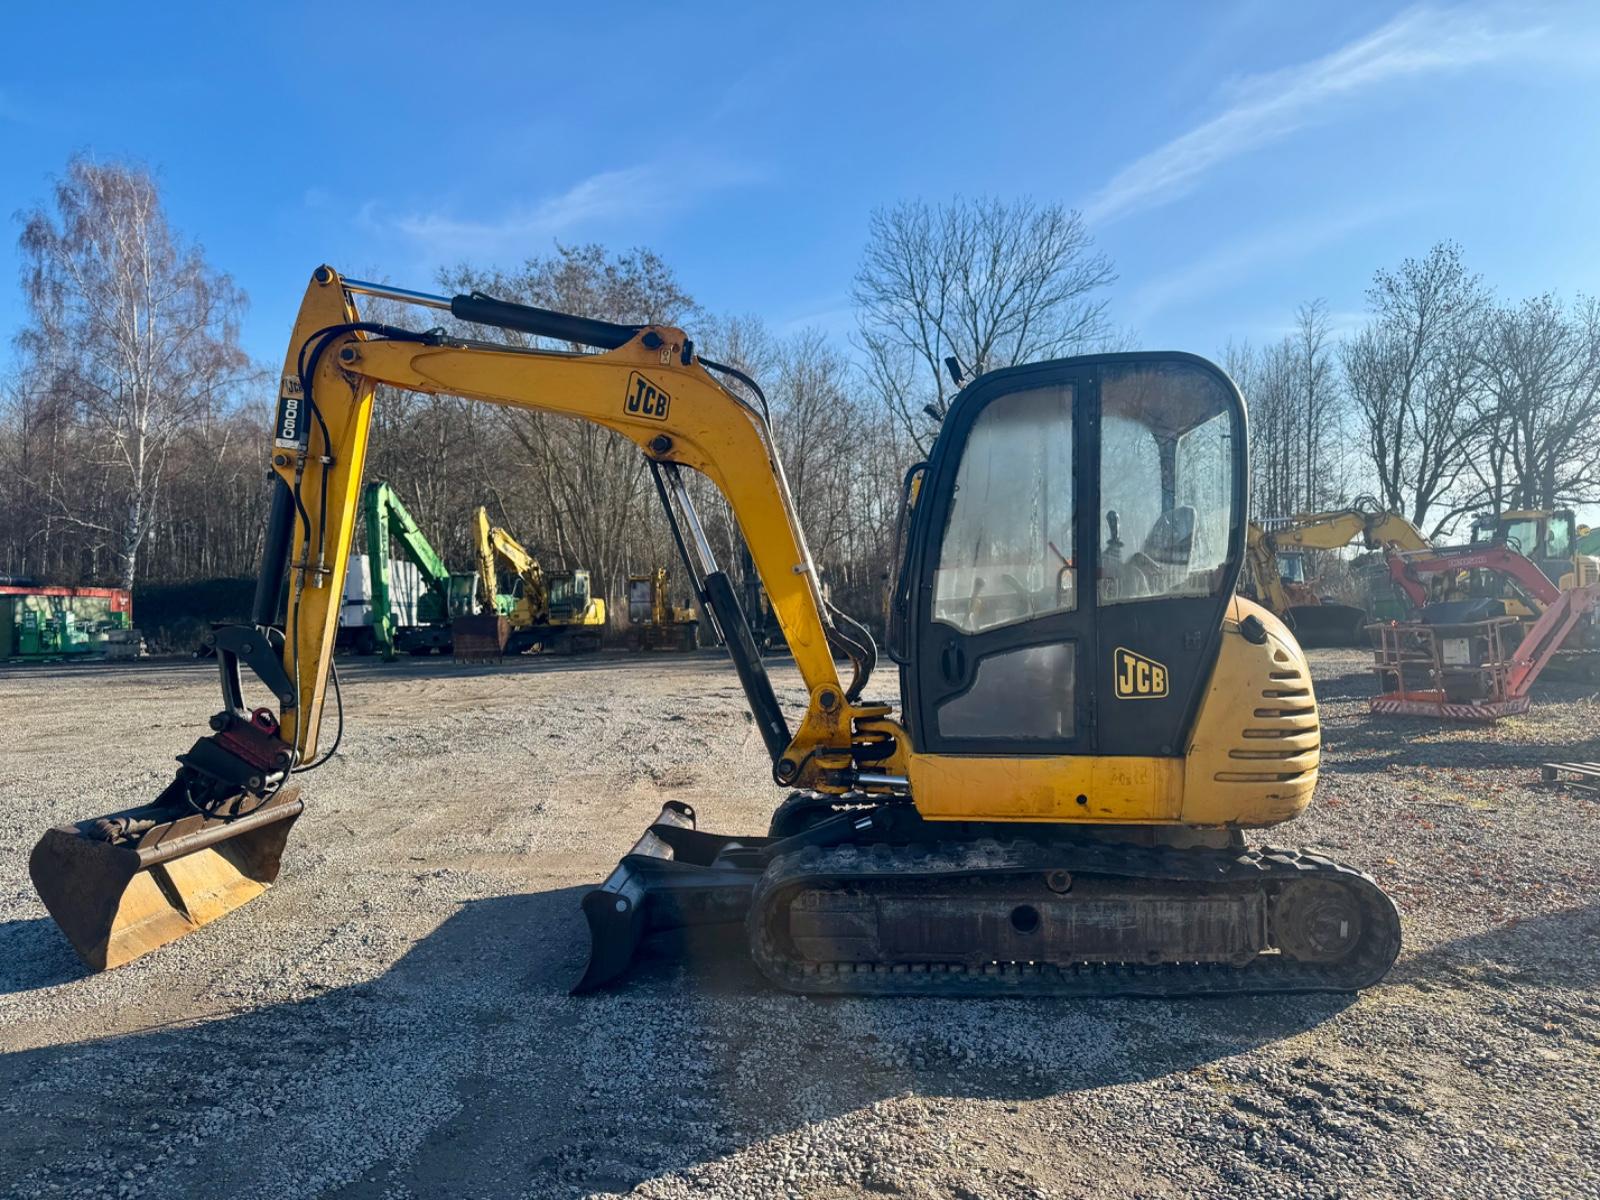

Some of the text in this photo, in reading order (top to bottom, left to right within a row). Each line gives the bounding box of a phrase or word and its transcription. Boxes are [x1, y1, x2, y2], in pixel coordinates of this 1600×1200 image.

[628, 378, 667, 416] JCB
[282, 399, 298, 439] 8060
[1119, 654, 1164, 694] JCB
